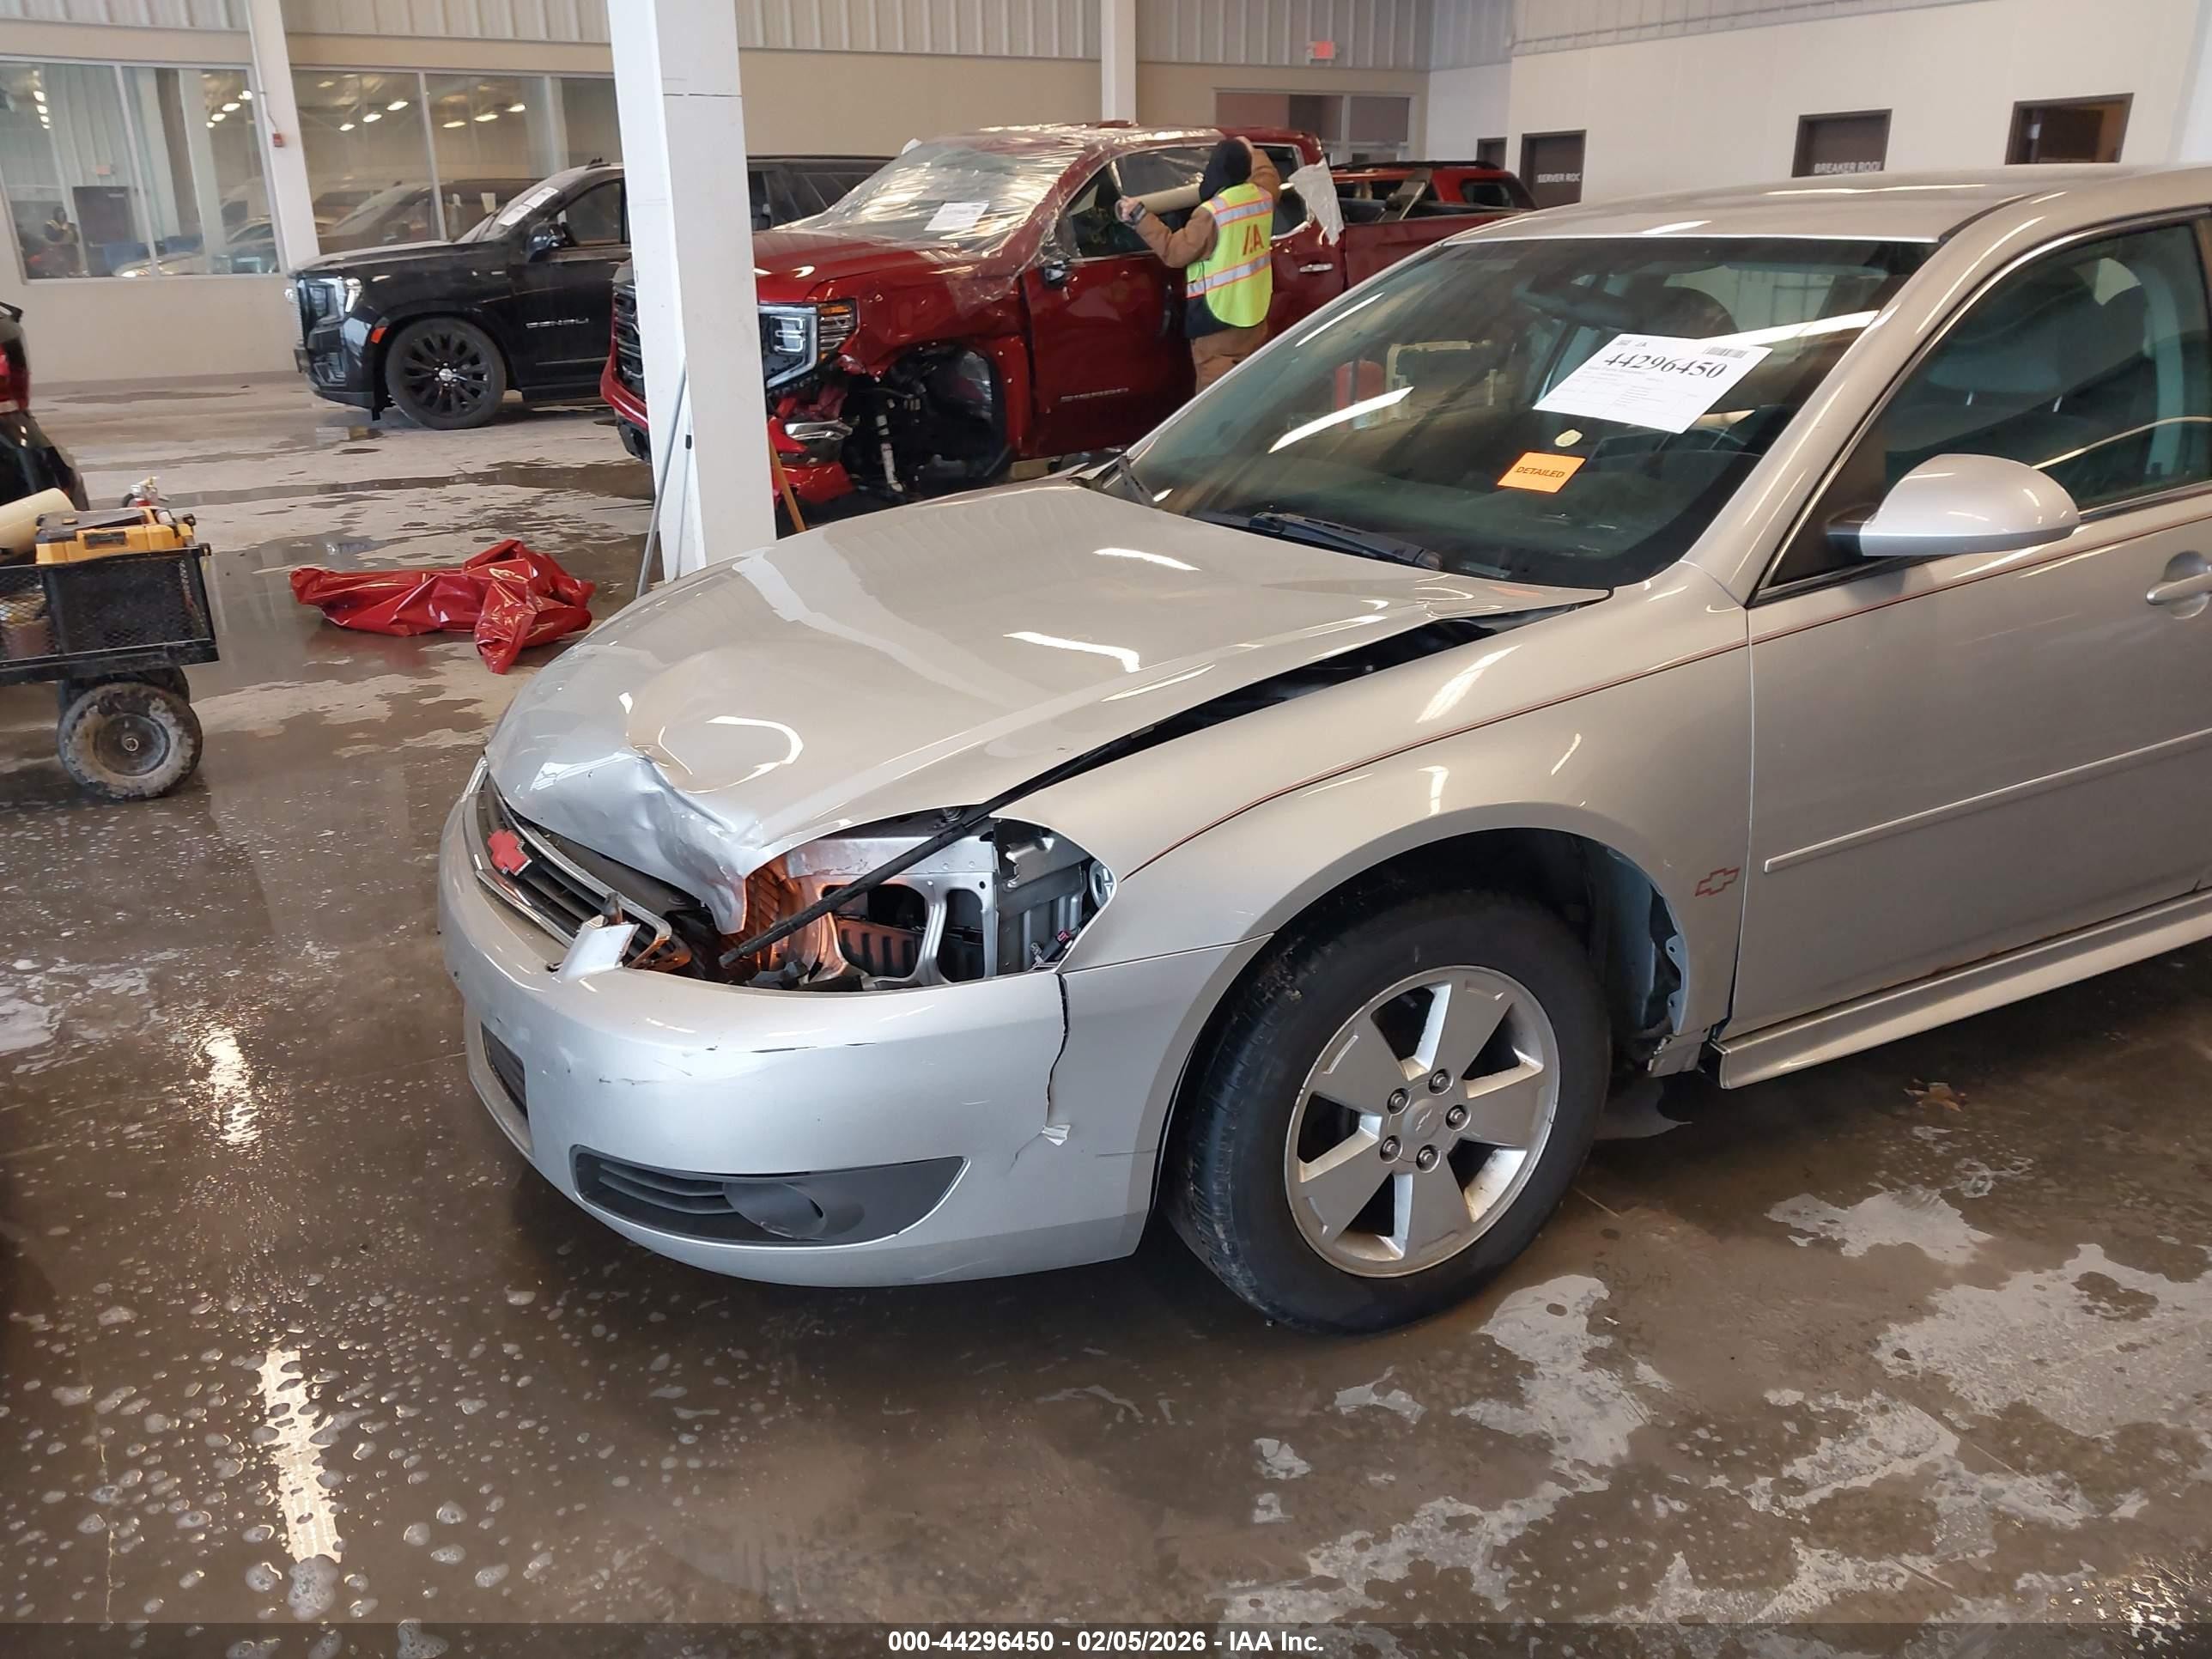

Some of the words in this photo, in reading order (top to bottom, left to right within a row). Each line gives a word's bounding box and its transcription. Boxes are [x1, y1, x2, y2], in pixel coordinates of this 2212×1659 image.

[1814, 162, 1856, 174] BREAKER
[1604, 351, 1727, 379] 44296450
[1516, 466, 1566, 478] DETAILED
